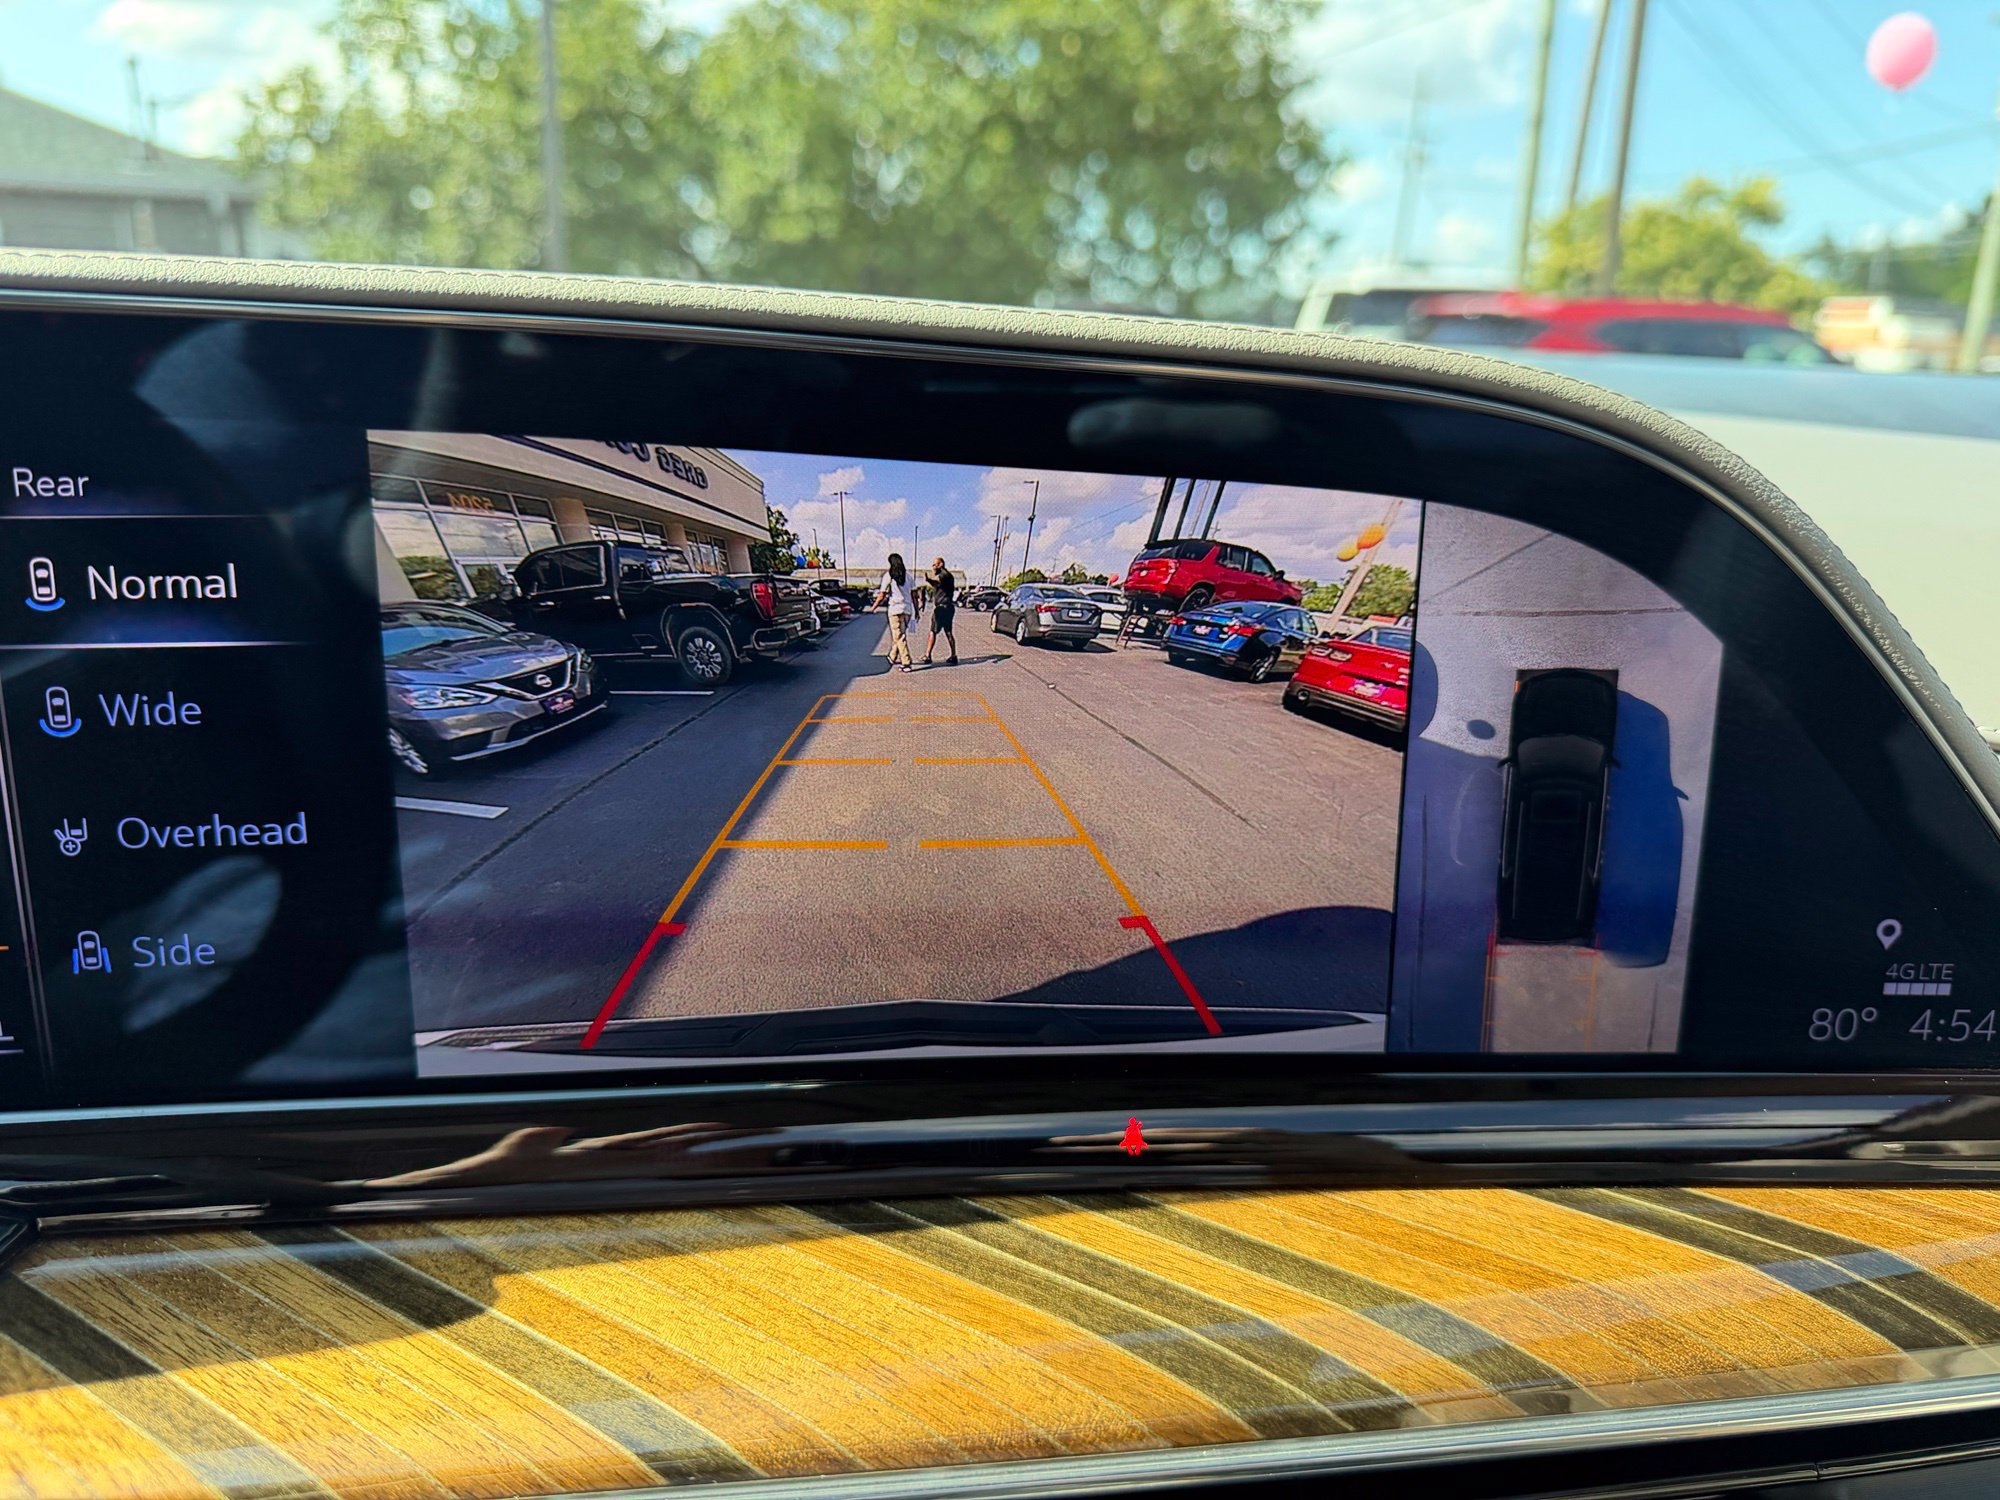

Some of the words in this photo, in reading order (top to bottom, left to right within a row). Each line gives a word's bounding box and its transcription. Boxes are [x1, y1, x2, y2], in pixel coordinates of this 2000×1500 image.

[12, 468, 90, 497] Rear
[87, 563, 239, 600] Normal
[99, 691, 203, 726] Wide
[117, 812, 309, 849] Overhead
[132, 934, 216, 967] Side
[1909, 1008, 1997, 1042] 4:54
